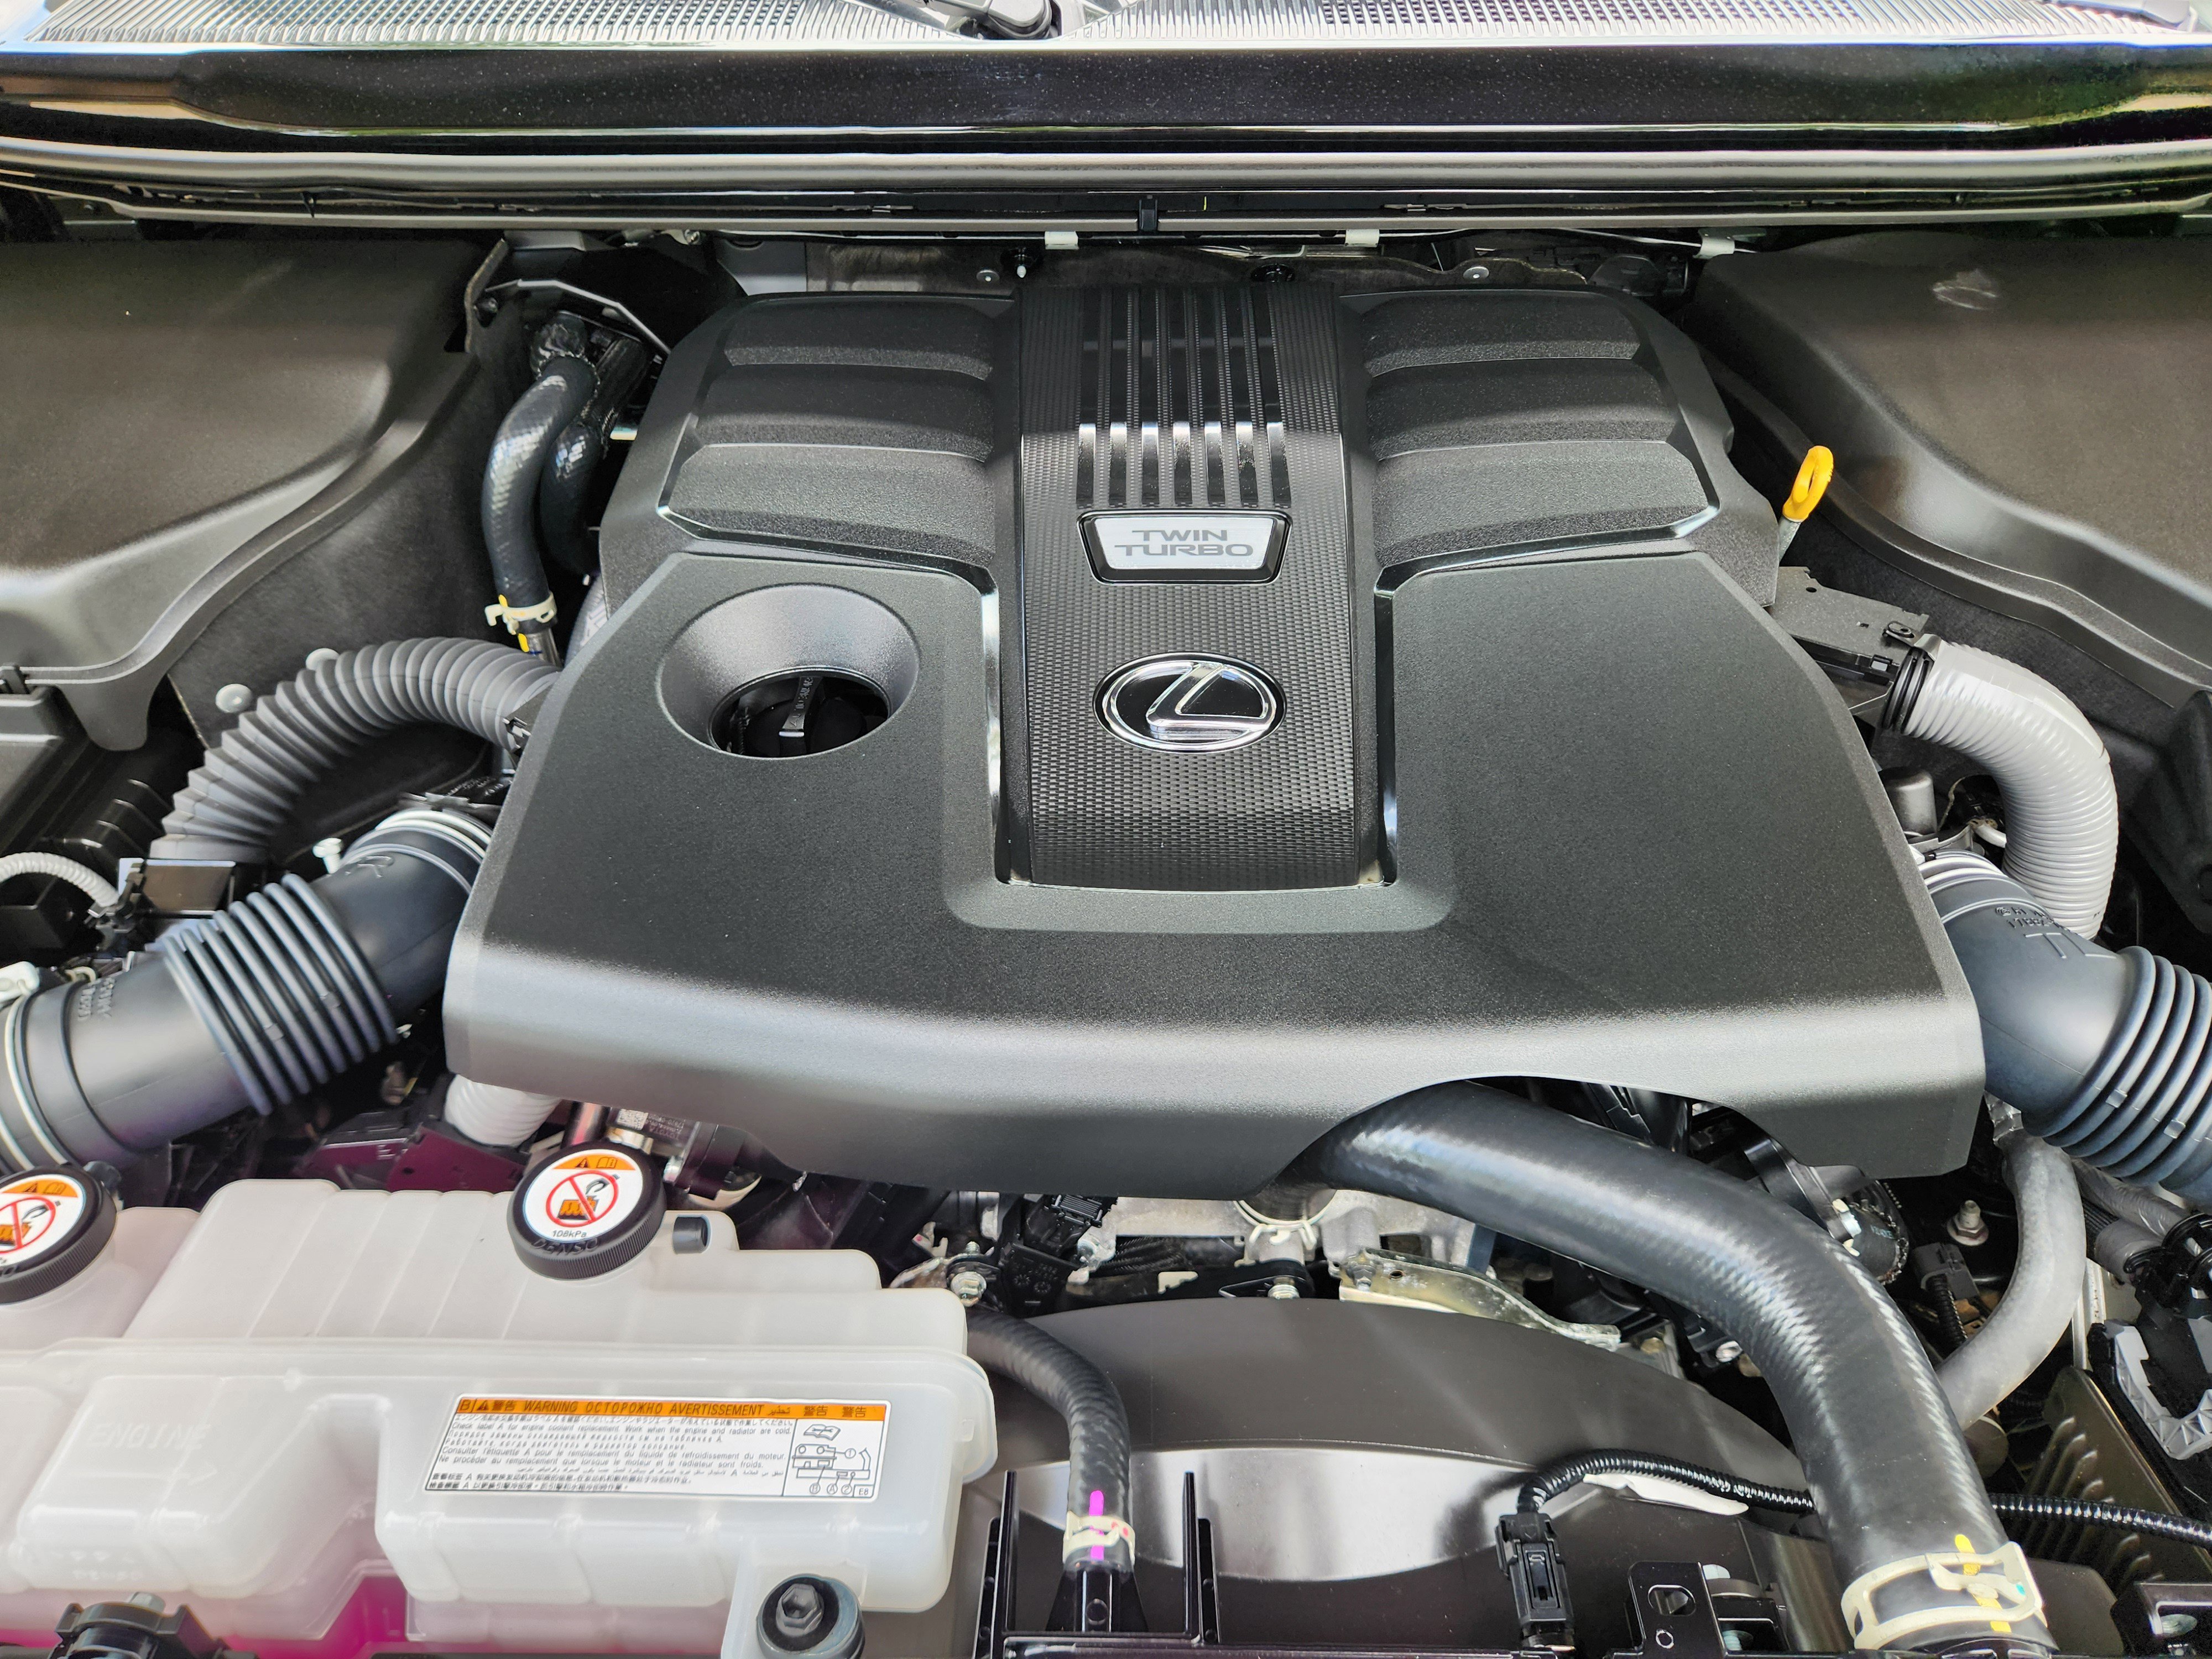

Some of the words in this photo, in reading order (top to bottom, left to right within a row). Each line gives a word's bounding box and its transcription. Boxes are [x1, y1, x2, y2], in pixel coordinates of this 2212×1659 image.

[1132, 530, 1227, 541] TWIN
[1115, 544, 1254, 556] TURBO
[552, 1229, 587, 1238] 108kPa
[531, 1238, 598, 1256] DENSO
[460, 1399, 471, 1411] B
[523, 1400, 579, 1413] WARNING
[586, 1401, 663, 1413] ОСТОРОЖНО
[669, 1402, 765, 1416] AVERTISSEMENT
[804, 1405, 828, 1417] 警告
[842, 1406, 867, 1417] 警告
[442, 1446, 479, 1455] Consulter
[639, 1451, 664, 1459] liquide
[682, 1452, 740, 1460] refroidissement
[744, 1452, 754, 1460] du
[439, 1454, 449, 1463] Ne
[505, 1457, 559, 1465] remplacement
[581, 1458, 609, 1467] lorsque
[613, 1458, 621, 1466] le
[625, 1458, 651, 1467] moteur
[679, 1460, 714, 1468] radiateur
[740, 1460, 763, 1469] froids.
